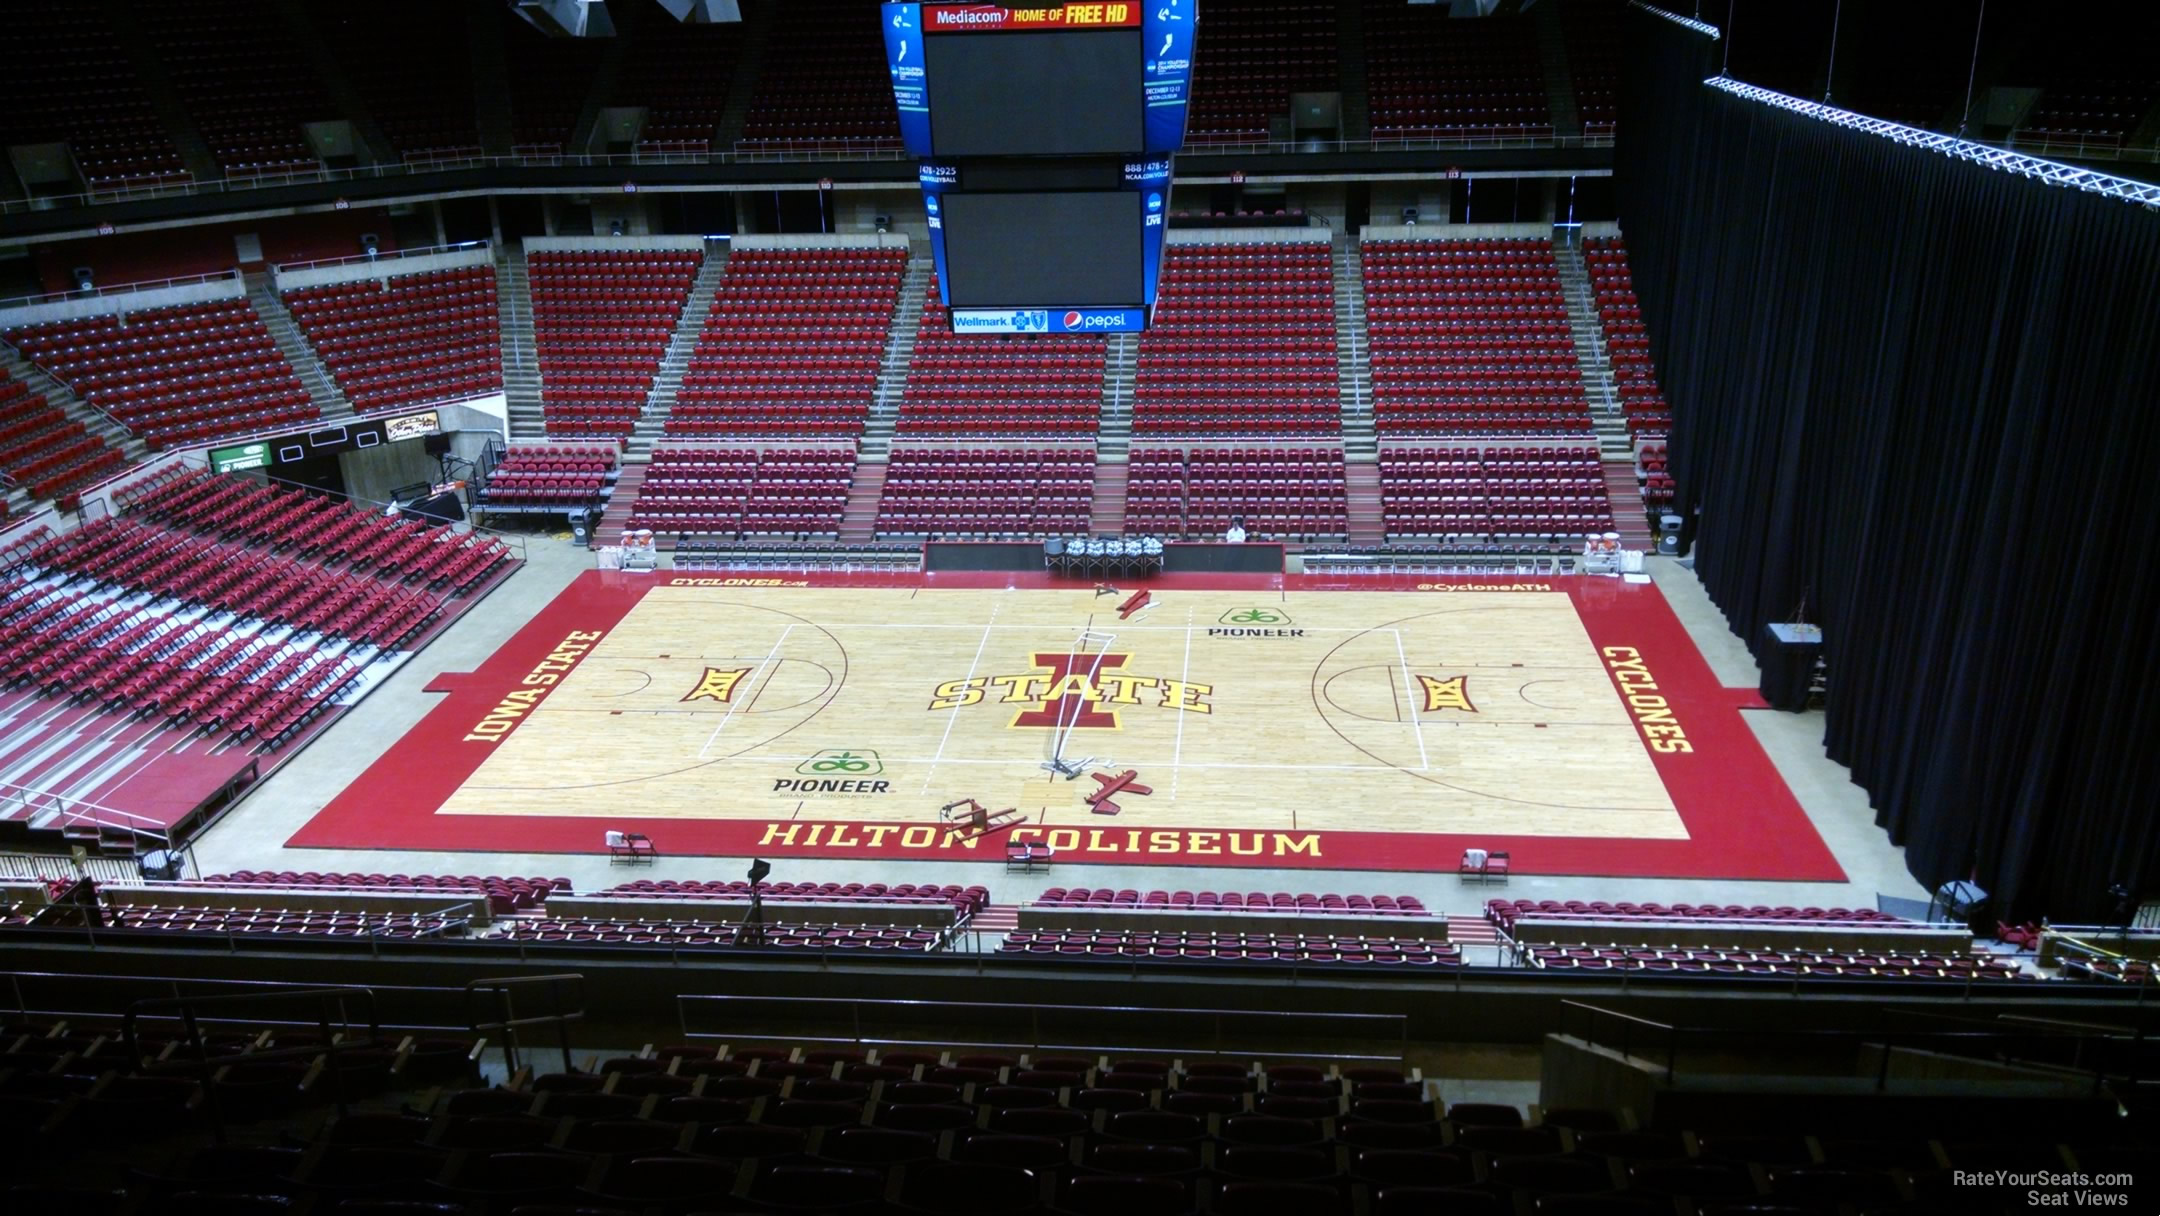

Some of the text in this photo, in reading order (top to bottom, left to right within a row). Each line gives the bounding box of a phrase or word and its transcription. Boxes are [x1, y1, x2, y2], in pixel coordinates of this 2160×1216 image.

[937, 10, 1001, 24] Mediacom
[1014, 4, 1128, 24] HOME OF FREE HD
[1085, 313, 1123, 328] pepsi
[1417, 583, 1551, 592] @CycloneATH
[1208, 628, 1304, 637] PIONEER
[462, 630, 602, 741] IOWA STATE
[928, 674, 1213, 714] STATE
[1603, 646, 1694, 753] CYCLONES
[773, 779, 890, 793] PIONEER
[758, 824, 985, 849] HILTON
